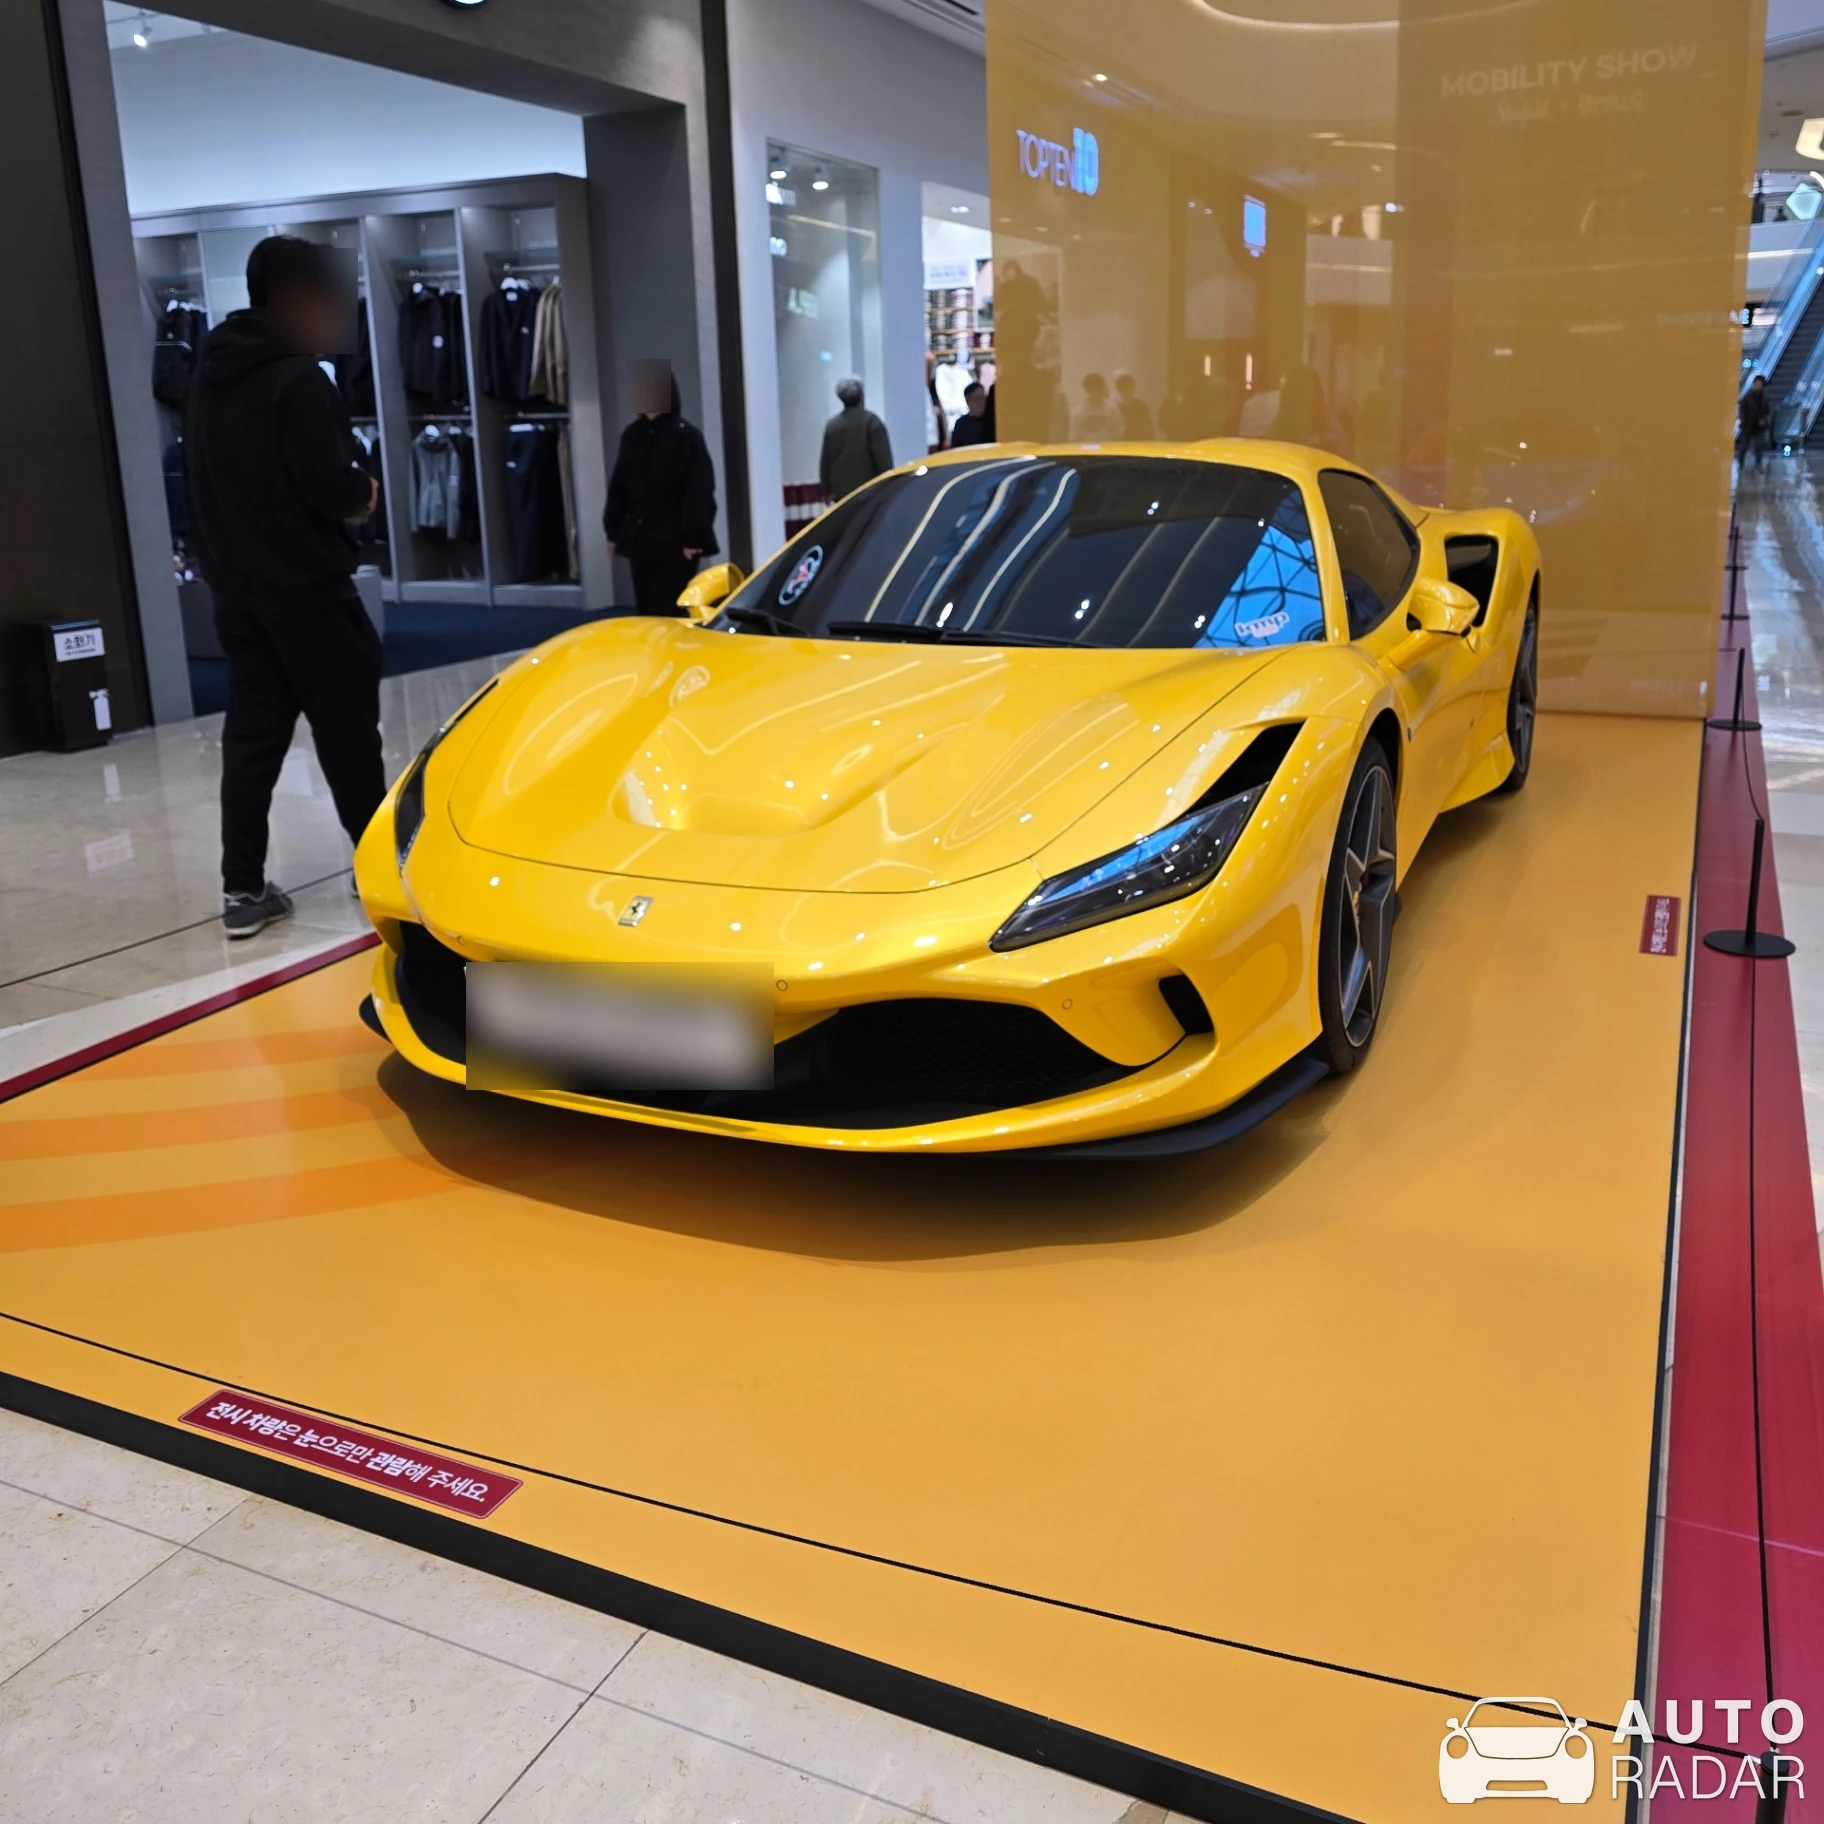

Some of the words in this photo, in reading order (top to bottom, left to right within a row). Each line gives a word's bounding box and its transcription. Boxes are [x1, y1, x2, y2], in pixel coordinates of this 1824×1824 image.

[1440, 57, 1587, 97] MOBILITY
[1595, 42, 1700, 79] SHOW
[206, 1402, 252, 1425] 전시
[242, 1413, 302, 1441] 차량은
[293, 1429, 375, 1464] 눈으로만
[365, 1452, 433, 1483] 관람해
